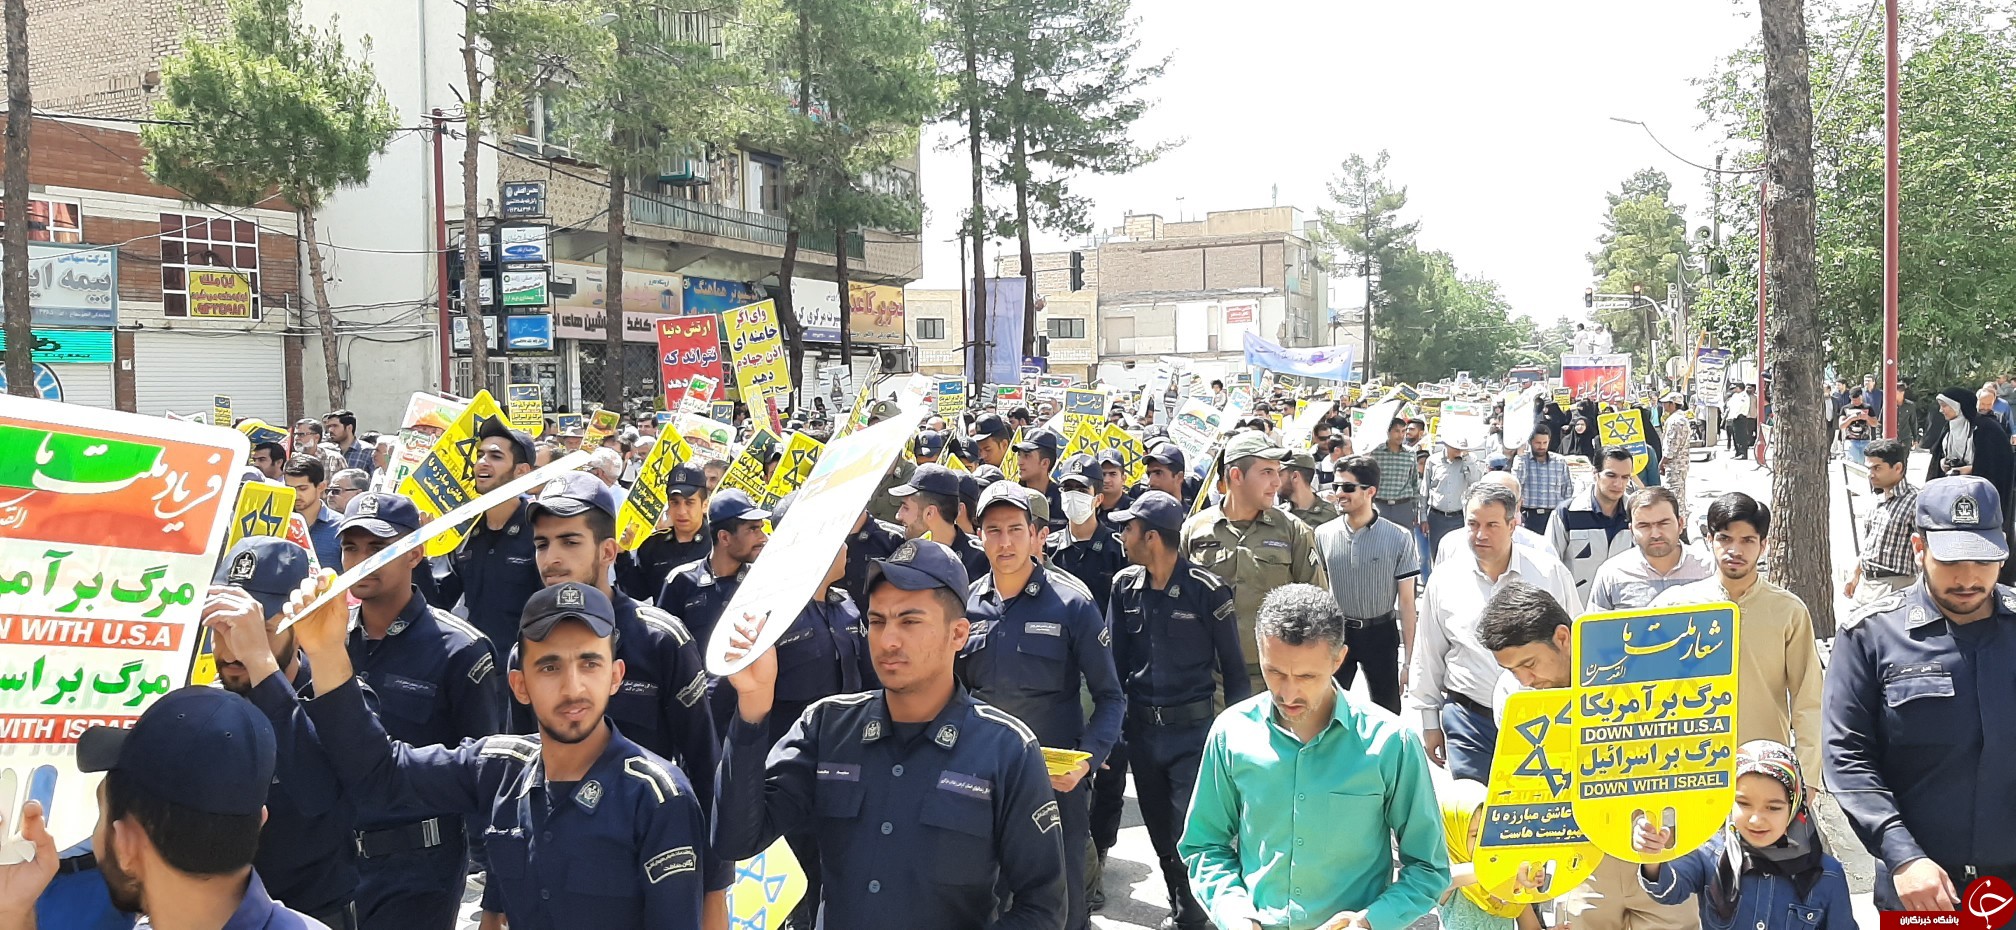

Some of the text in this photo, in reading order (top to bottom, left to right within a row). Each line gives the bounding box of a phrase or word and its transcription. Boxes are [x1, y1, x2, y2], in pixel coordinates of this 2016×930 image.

[57, 253, 110, 267] شرکت سهامی
[60, 269, 111, 302] بیمه
[694, 280, 728, 297] هماهنگ
[562, 313, 583, 328] های
[627, 317, 652, 332] کاغذ
[736, 308, 749, 330] اگر
[750, 306, 767, 324] وای
[663, 320, 711, 338] ارتش دنیا
[733, 324, 778, 352] خامنه ای
[664, 346, 718, 368] نتواند که
[736, 345, 783, 374] اذن جهادم
[668, 378, 689, 389] دهد
[751, 371, 775, 385] دهد
[31, 432, 223, 533] فریاد ملت ما
[55, 571, 104, 613] بر
[110, 564, 195, 618] مرگ
[21, 618, 95, 644] WITH
[101, 622, 171, 647] U.S.A
[1622, 616, 1724, 661] شعار ملت ما
[40, 667, 84, 706] بر
[92, 659, 171, 707] مرگ
[1580, 683, 1732, 723] مرگ بر آمریکا
[1585, 718, 1725, 742] DOWN WITH U.S.A
[1580, 738, 1731, 776] مرگ بر اسرائیل
[1584, 773, 1724, 797] DOWN WITH ISRAEL
[1491, 806, 1572, 825] عاشق مبارزه با
[1500, 824, 1583, 840] هیونیست هاست
